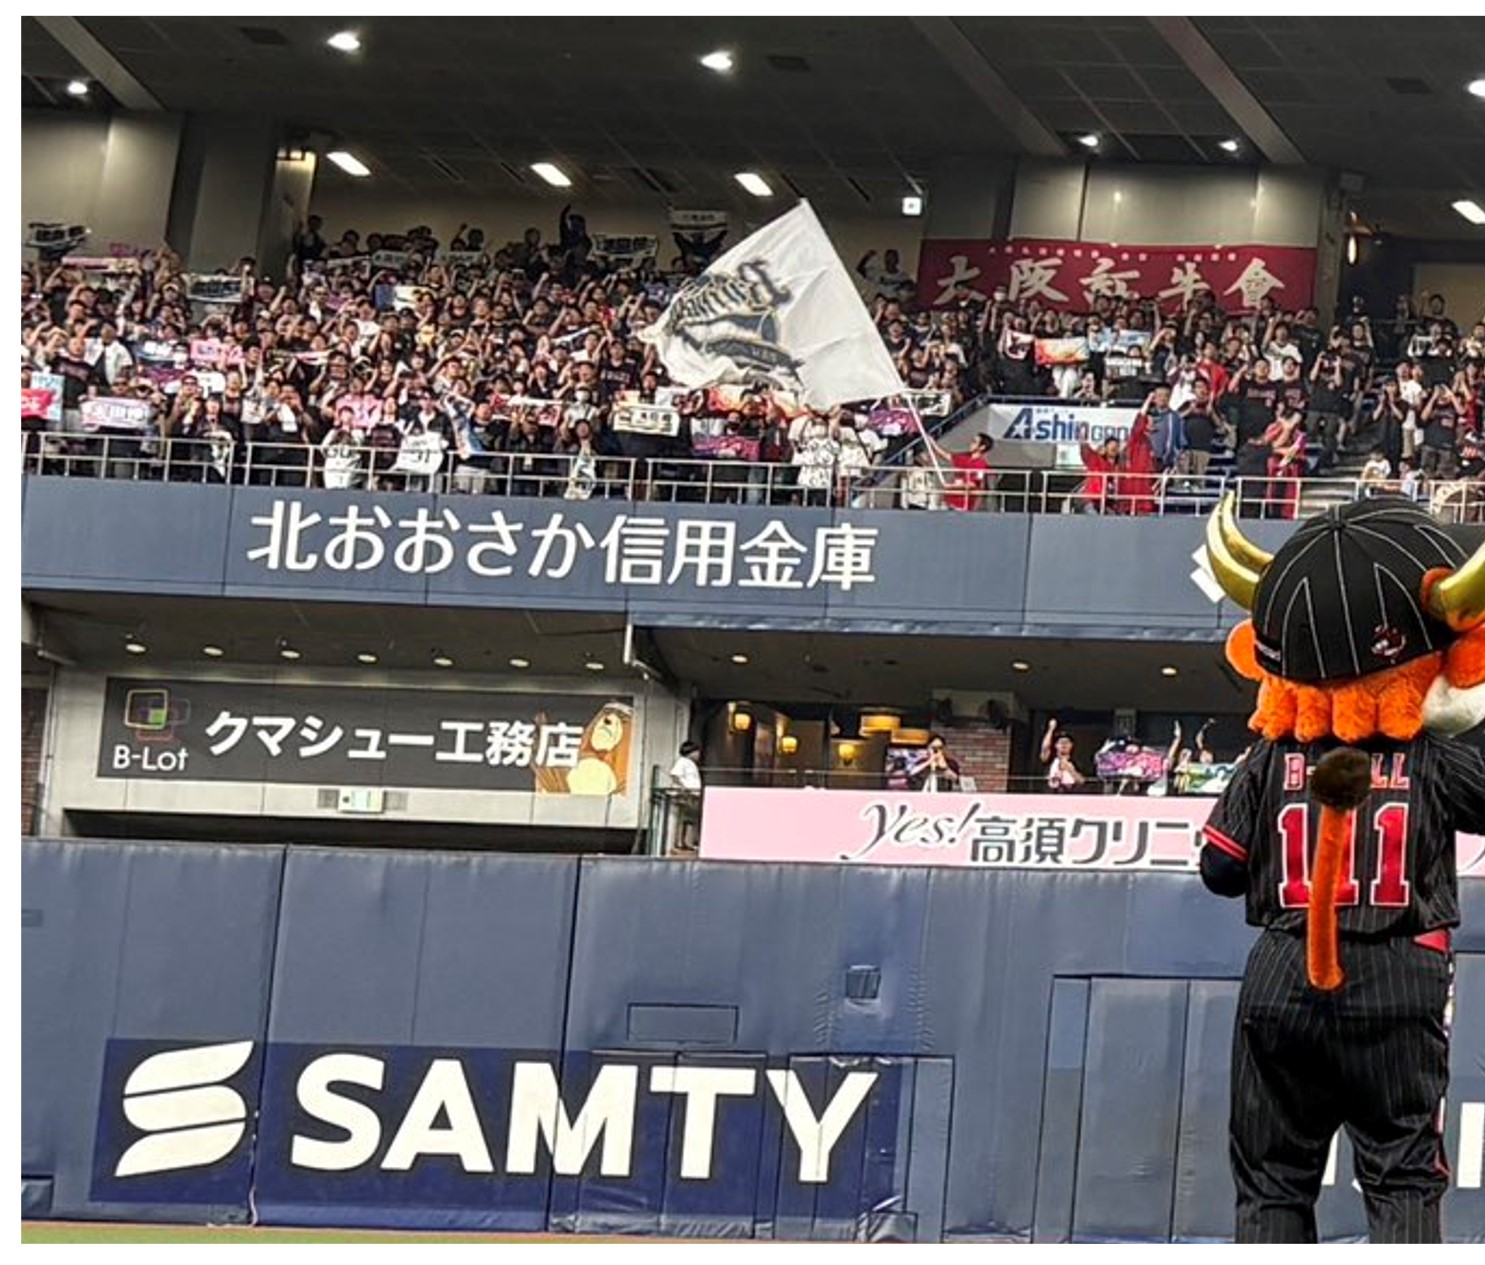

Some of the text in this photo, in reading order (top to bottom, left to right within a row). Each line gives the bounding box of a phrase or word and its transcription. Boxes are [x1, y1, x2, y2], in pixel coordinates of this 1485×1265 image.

[1004, 407, 1089, 442] Ashin
[247, 499, 879, 592] 北おおさか信用金庫
[112, 743, 189, 772] B-Lot
[205, 710, 583, 769] クマシュー工務店
[1283, 752, 1410, 791] B-LL
[971, 815, 1202, 866] 高須クリニ
[290, 1052, 879, 1183] SAMTY
